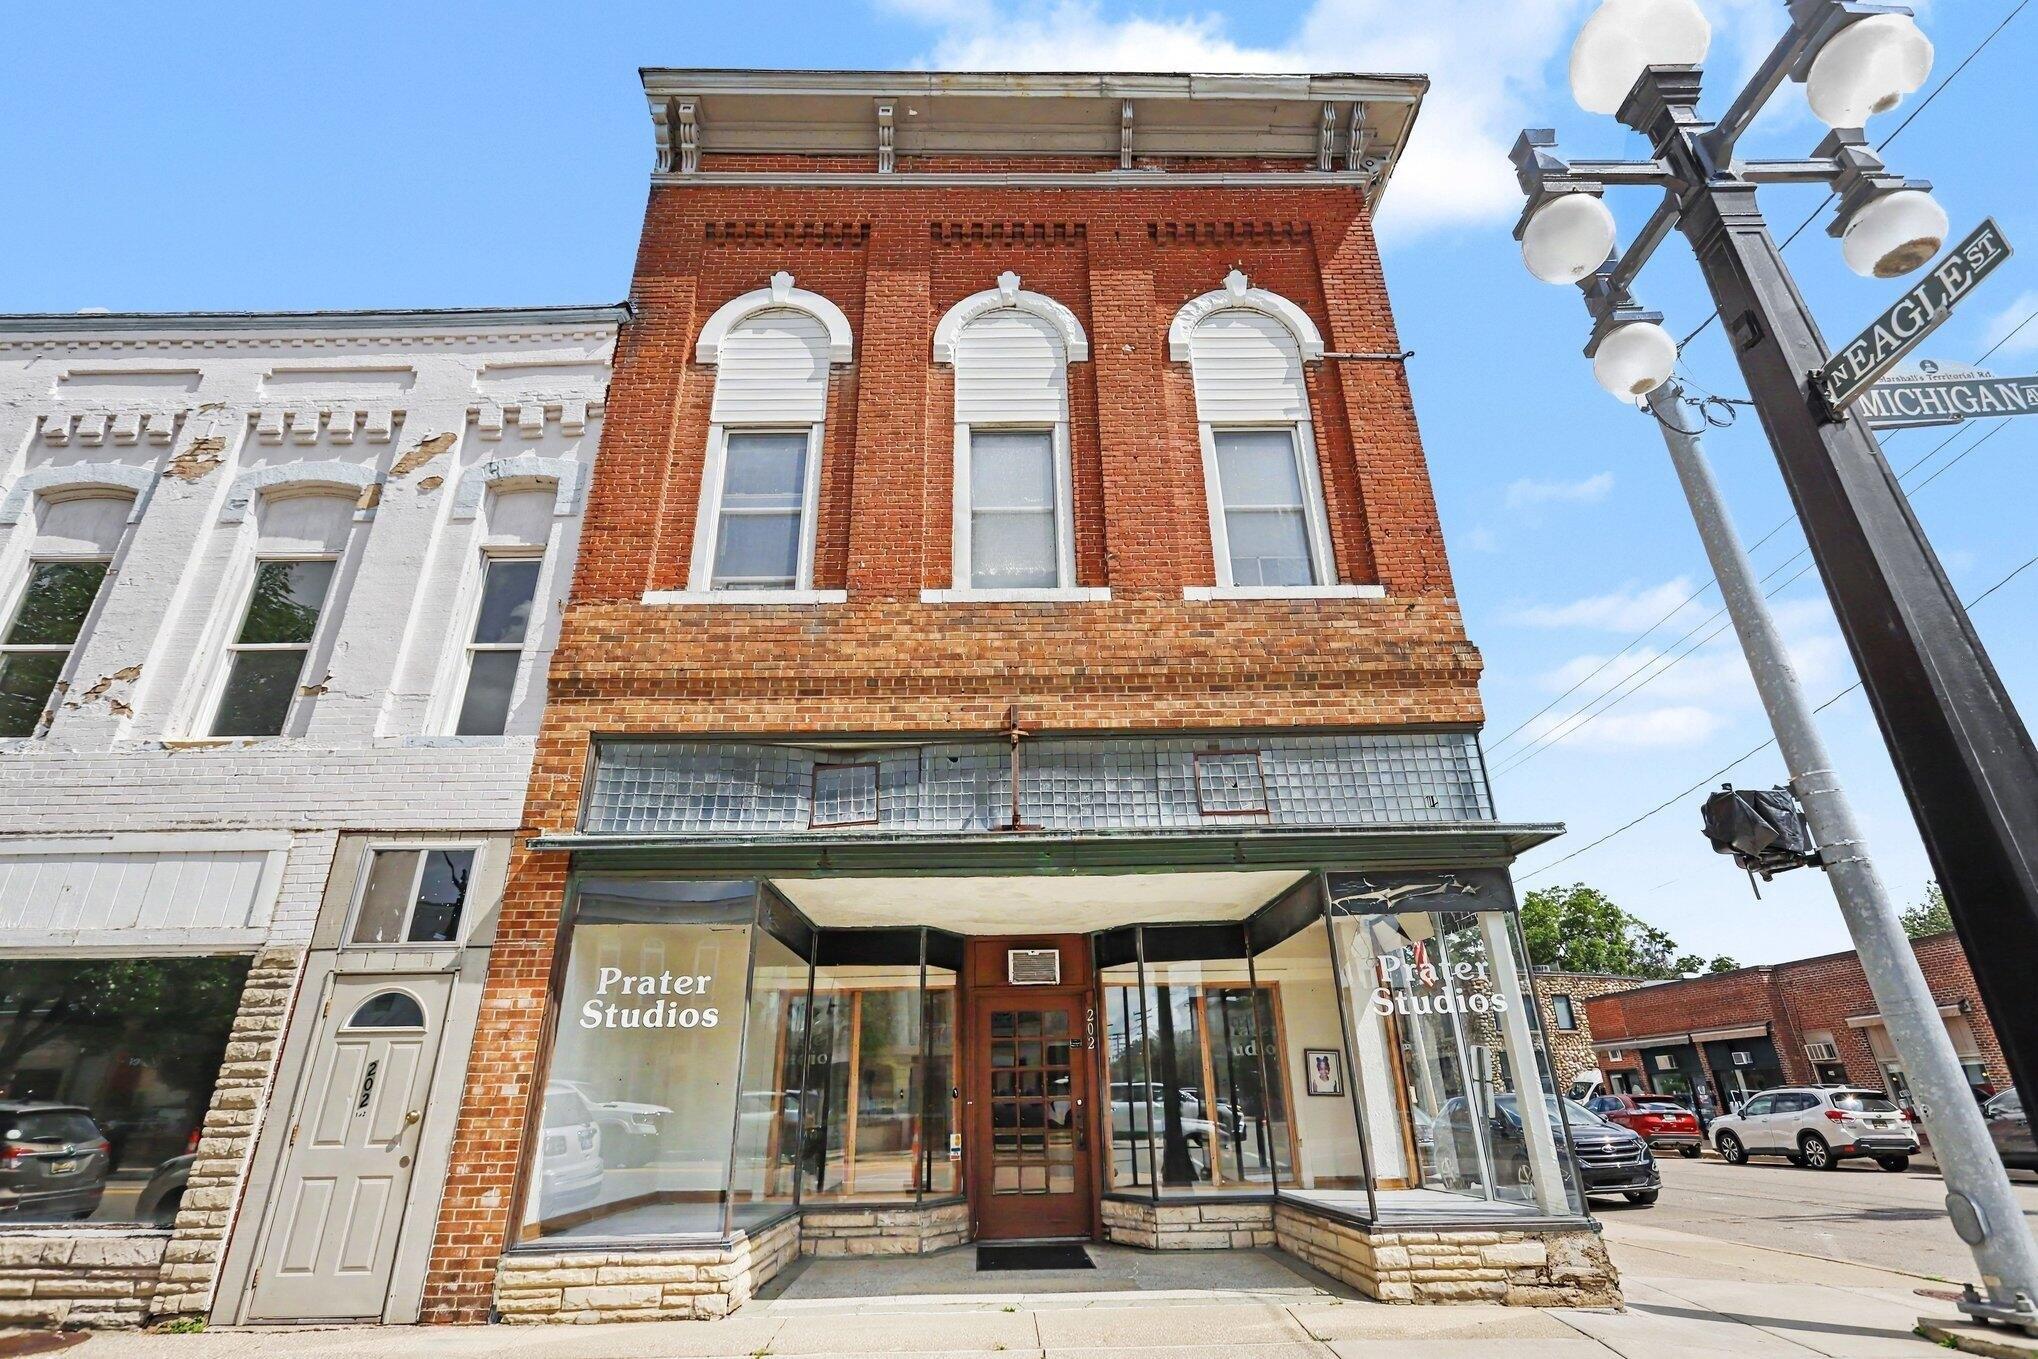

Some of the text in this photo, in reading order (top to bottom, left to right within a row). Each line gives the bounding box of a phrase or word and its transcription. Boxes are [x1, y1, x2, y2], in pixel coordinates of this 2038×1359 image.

[1831, 232, 1997, 388] N EAGLE ST
[1858, 383, 2028, 418] MICHIGAN
[597, 967, 712, 995] Prater
[1377, 954, 1489, 982] Prater
[579, 999, 719, 1029] Studios
[1371, 986, 1508, 1016] Studios
[1086, 1009, 1095, 1050] 202
[360, 1062, 377, 1108] 202
